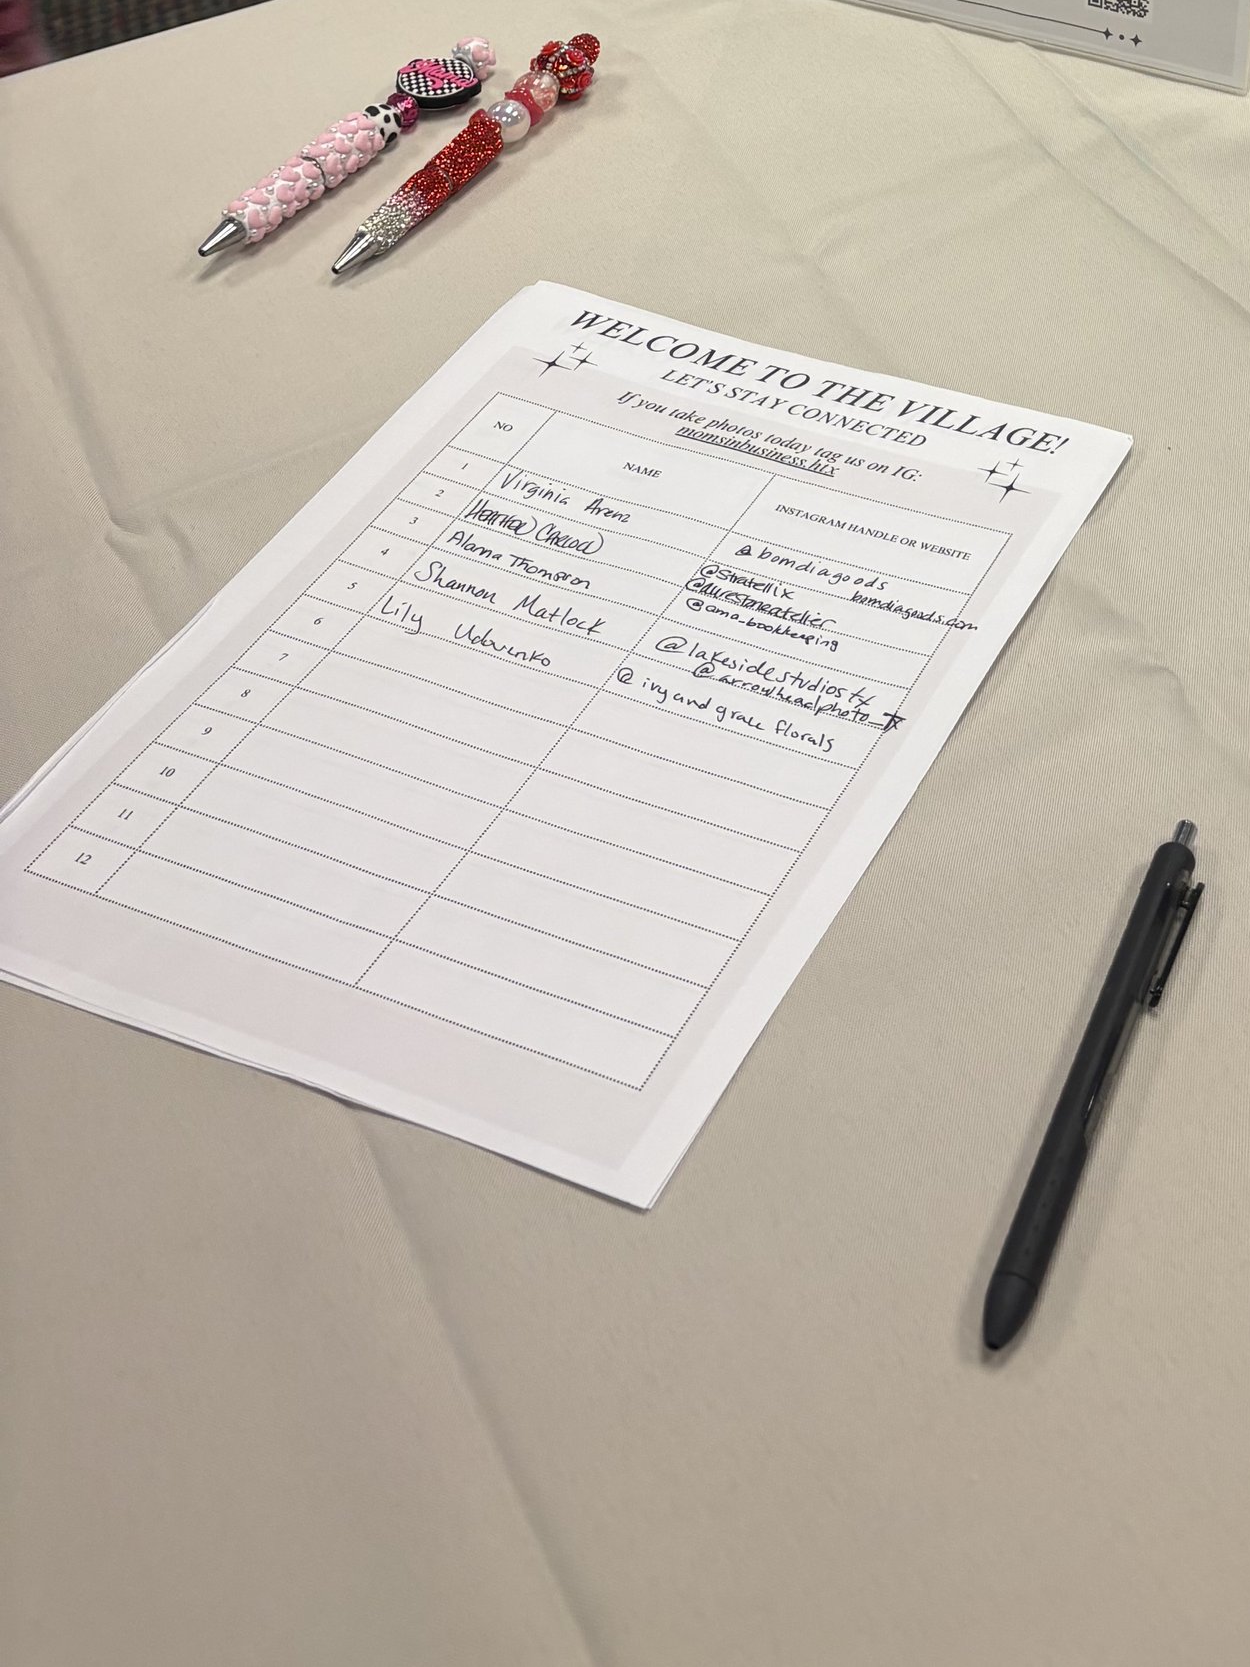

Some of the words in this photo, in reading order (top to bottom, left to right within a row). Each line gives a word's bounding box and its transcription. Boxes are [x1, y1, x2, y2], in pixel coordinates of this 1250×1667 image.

[570, 309, 758, 376] WELCOME
[755, 364, 811, 389] TO
[812, 379, 896, 412] THE
[897, 399, 1070, 454] VILLAGE!
[660, 369, 726, 394] LET'S
[723, 386, 789, 409] STAY
[787, 404, 927, 446] CONNECTED
[616, 391, 642, 404] If
[631, 399, 668, 414] you
[668, 408, 706, 424] take
[701, 418, 763, 443] photos
[763, 433, 812, 454] today
[813, 447, 843, 463] tag
[843, 456, 866, 467] us
[866, 462, 889, 474] on
[890, 465, 922, 482] IG:
[674, 426, 840, 478] momsinbusiness.htx
[500, 470, 570, 505] Virginia
[622, 461, 662, 478] NAME
[775, 504, 847, 529] INSTAGRAM
[847, 523, 899, 543] HANDLE
[899, 537, 917, 548] OR
[920, 541, 972, 561] WEBSITE
[381, 596, 423, 635] Lily
[413, 560, 496, 604] Shannon
[512, 594, 606, 635] Matlock
